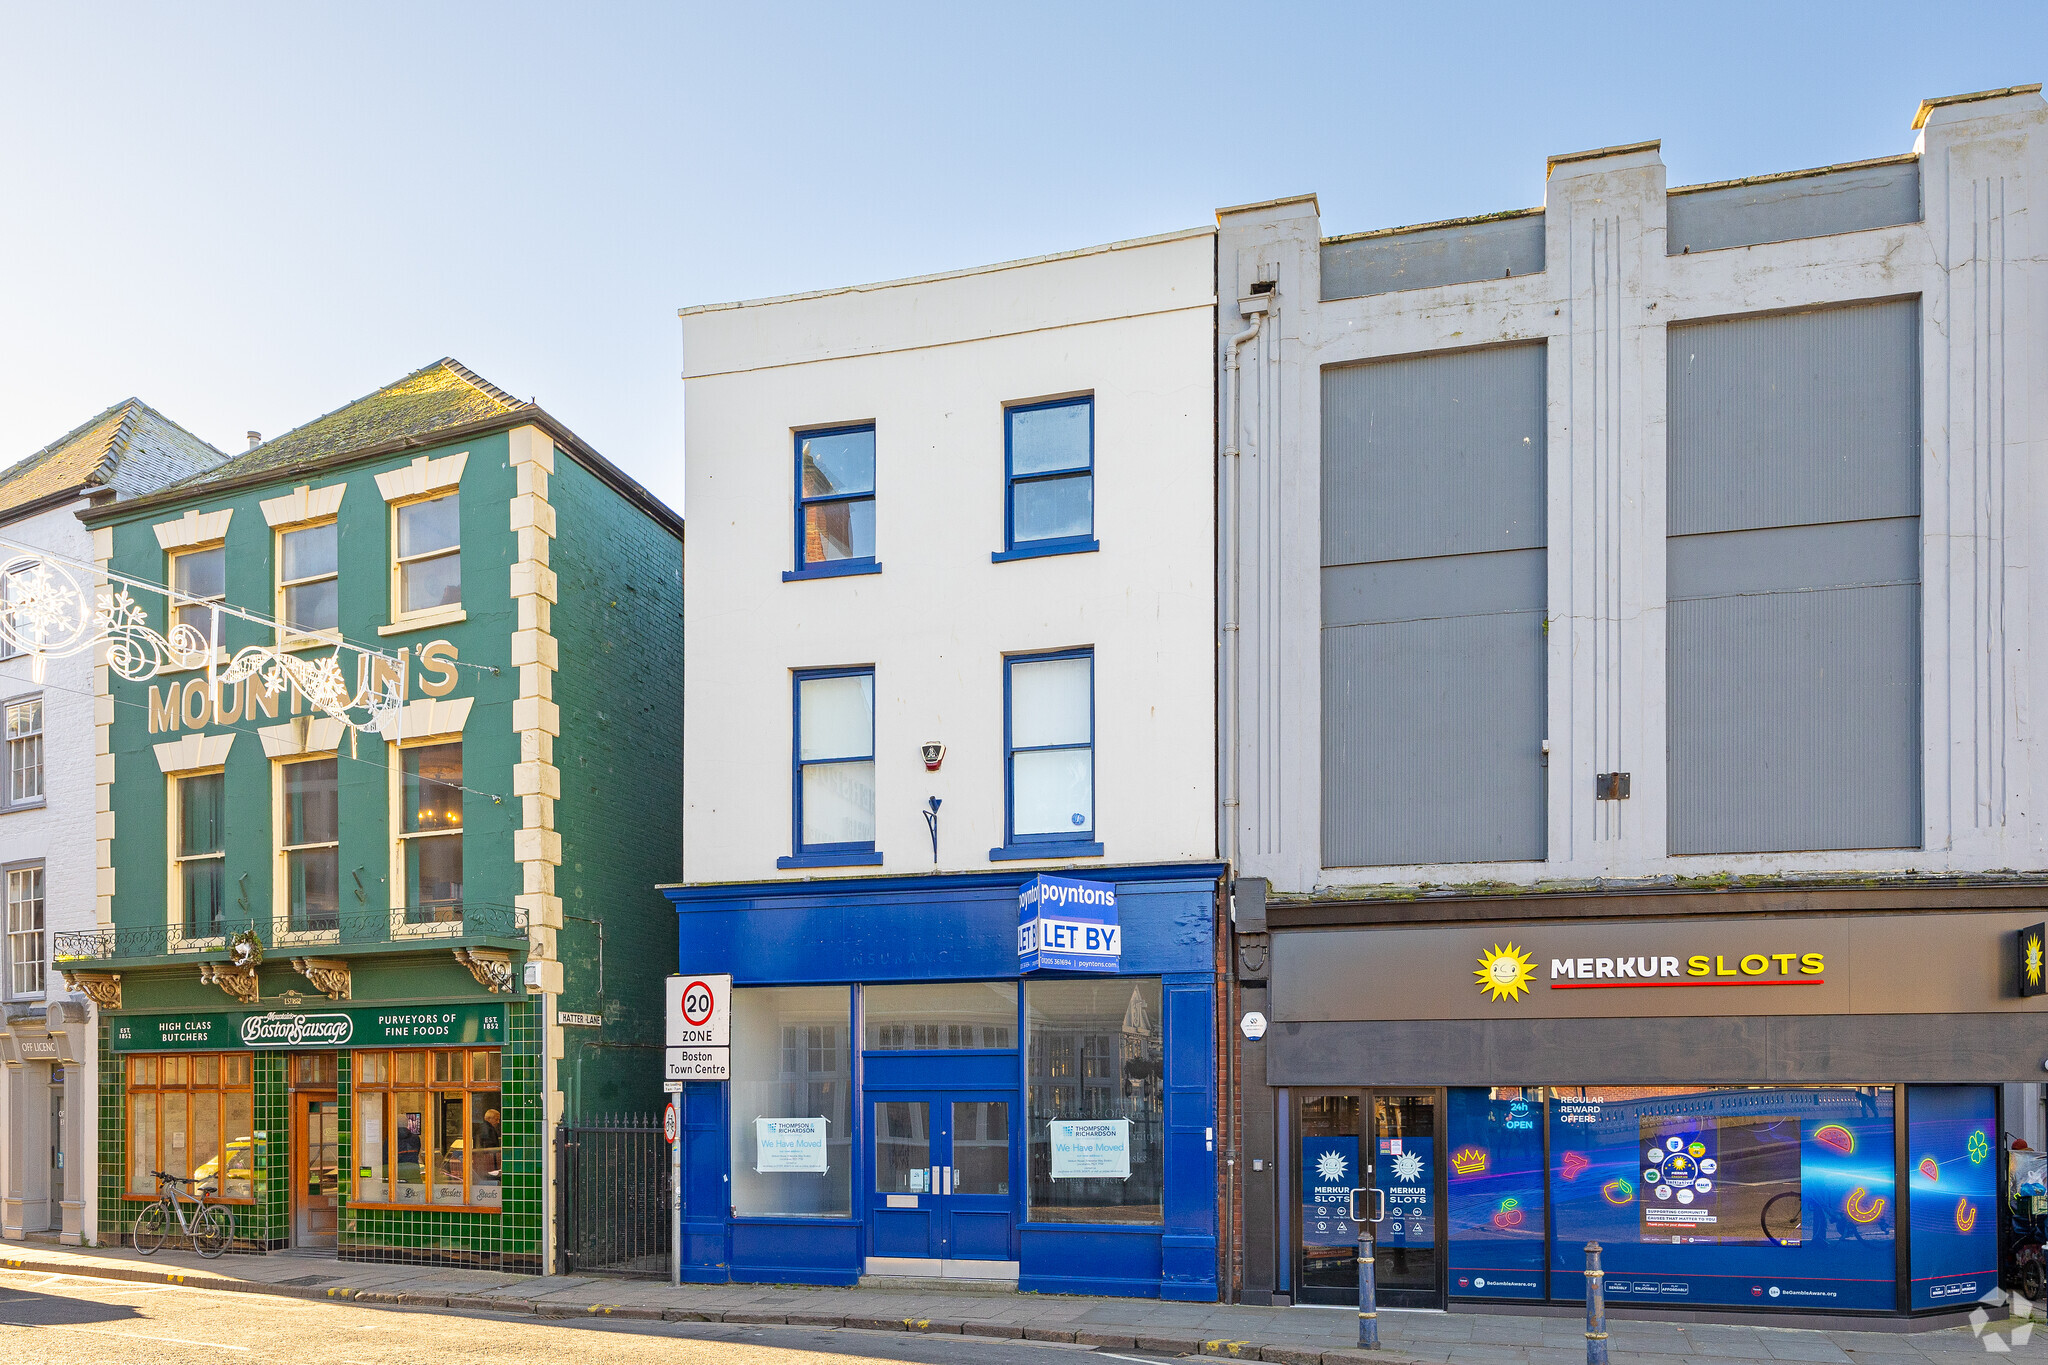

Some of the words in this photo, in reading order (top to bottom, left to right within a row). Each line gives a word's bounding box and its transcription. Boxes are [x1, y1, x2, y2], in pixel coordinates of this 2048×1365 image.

[1041, 883, 1115, 907] poyntons
[1044, 923, 1079, 949] LET
[1086, 927, 1116, 951] BY
[845, 951, 962, 966] NSURANCE
[1041, 957, 1053, 965] 01205
[1054, 958, 1072, 966] 361694
[1078, 960, 1117, 968] poyntons.com
[1551, 955, 1681, 980] MERKUR
[1687, 953, 1825, 977] SLOTS
[686, 994, 710, 1013] 20
[378, 1014, 438, 1025] PURVEYORS
[442, 1013, 457, 1023] OF
[562, 1013, 584, 1023] HATTER
[586, 1015, 601, 1025] LANE
[159, 1022, 183, 1031] HIGH
[184, 1021, 212, 1030] CLASS
[243, 1016, 295, 1041] Boston
[288, 1015, 348, 1045] Sausage
[385, 1027, 409, 1036] FINE
[413, 1026, 449, 1036] FOODS
[162, 1032, 208, 1042] BUTCHERS
[682, 1031, 713, 1042] ZONE
[21, 1043, 33, 1052] OFF
[682, 1051, 713, 1062] Boston
[669, 1064, 693, 1074] Town
[695, 1064, 726, 1074] Centre
[1560, 1096, 1604, 1104] REGULAR
[1510, 1102, 1528, 1112] 24h
[1560, 1105, 1601, 1113] REWARD
[1560, 1115, 1597, 1123] OFFERS
[1506, 1121, 1533, 1130] OPEN
[761, 1140, 774, 1148] We
[776, 1140, 794, 1148] Have
[796, 1139, 822, 1148] Moved
[1056, 1144, 1071, 1152] We
[1072, 1143, 1093, 1152] Have
[1095, 1142, 1125, 1152] Moved
[1314, 1186, 1350, 1194] MERKUR
[1314, 1195, 1350, 1203] SLOTS
[1389, 1196, 1427, 1204] SLOTS
[1782, 1289, 1837, 1297] BeGambleAware.org
